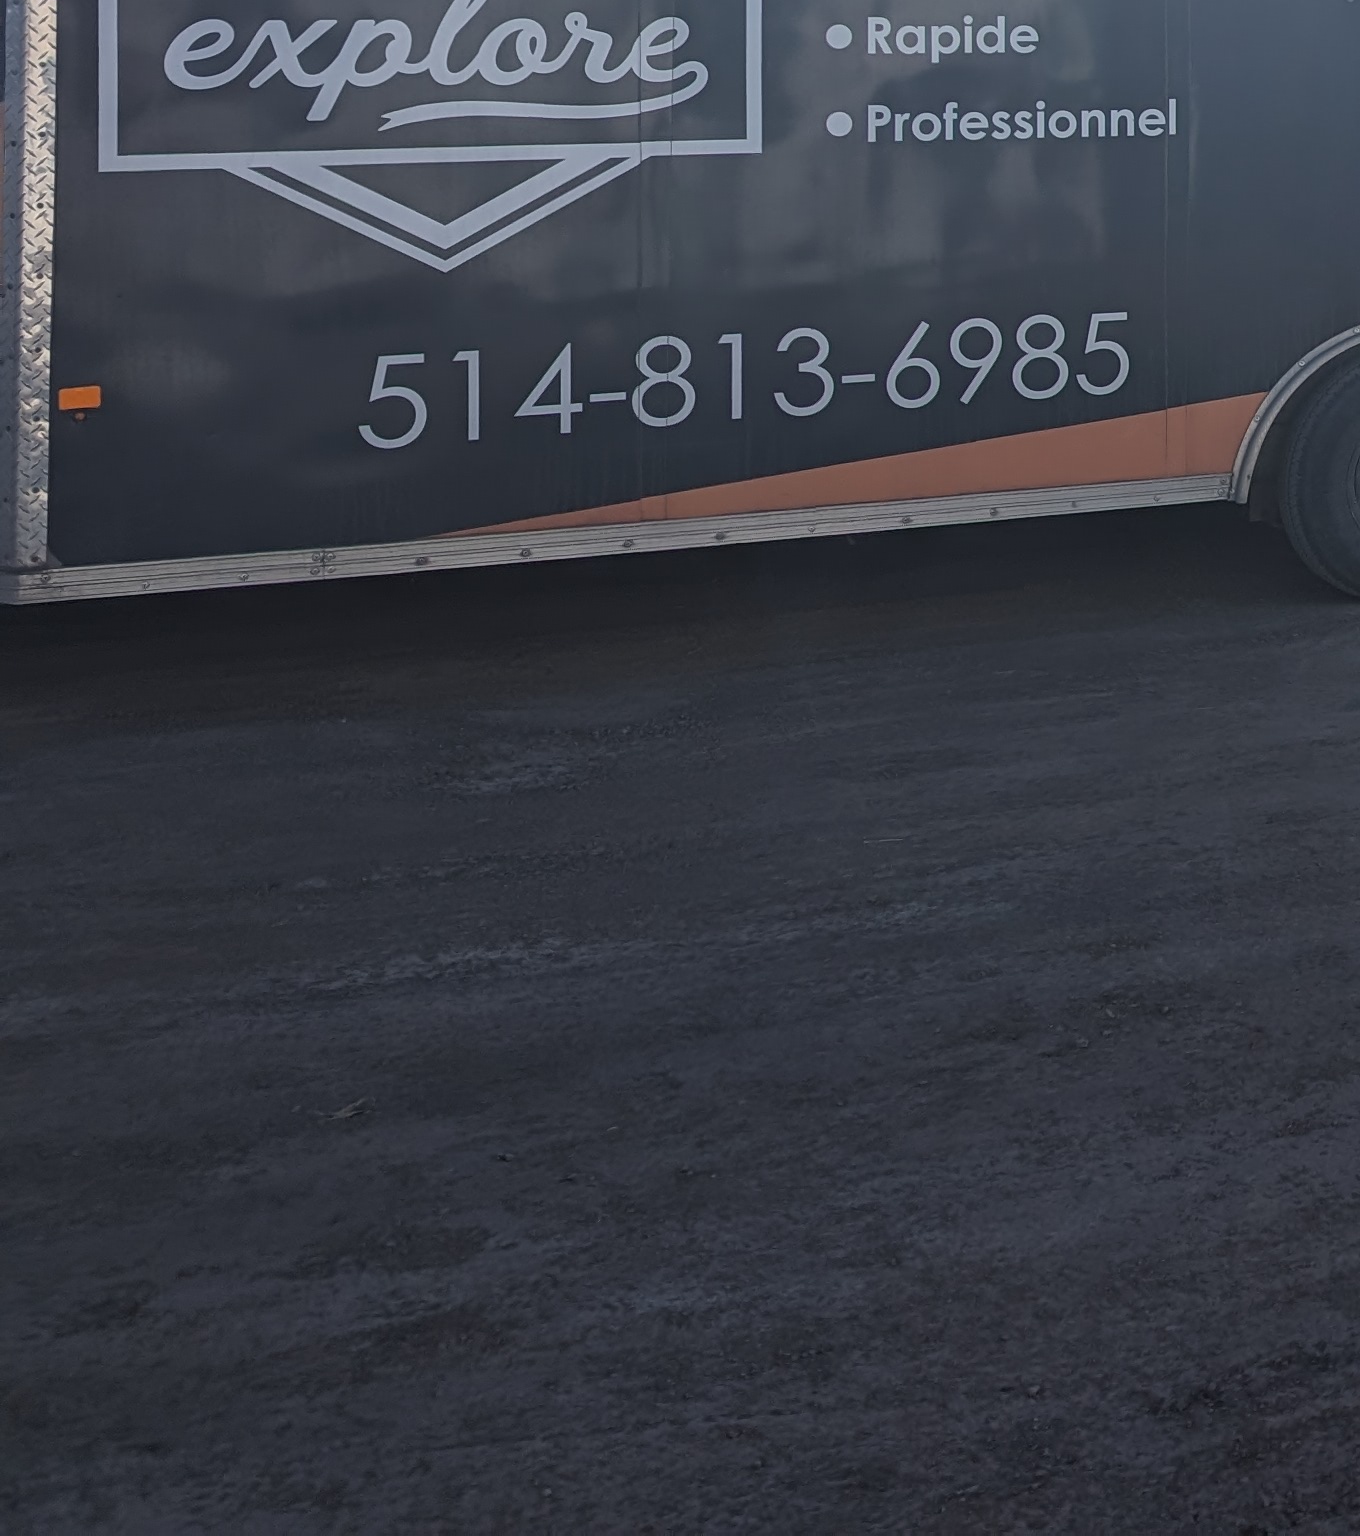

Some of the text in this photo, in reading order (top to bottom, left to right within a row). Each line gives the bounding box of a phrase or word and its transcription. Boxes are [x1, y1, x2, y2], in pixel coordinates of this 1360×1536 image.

[867, 15, 1039, 63] Rapide
[867, 99, 1177, 142] Professionnel
[358, 312, 1130, 449] 514-813-6985
